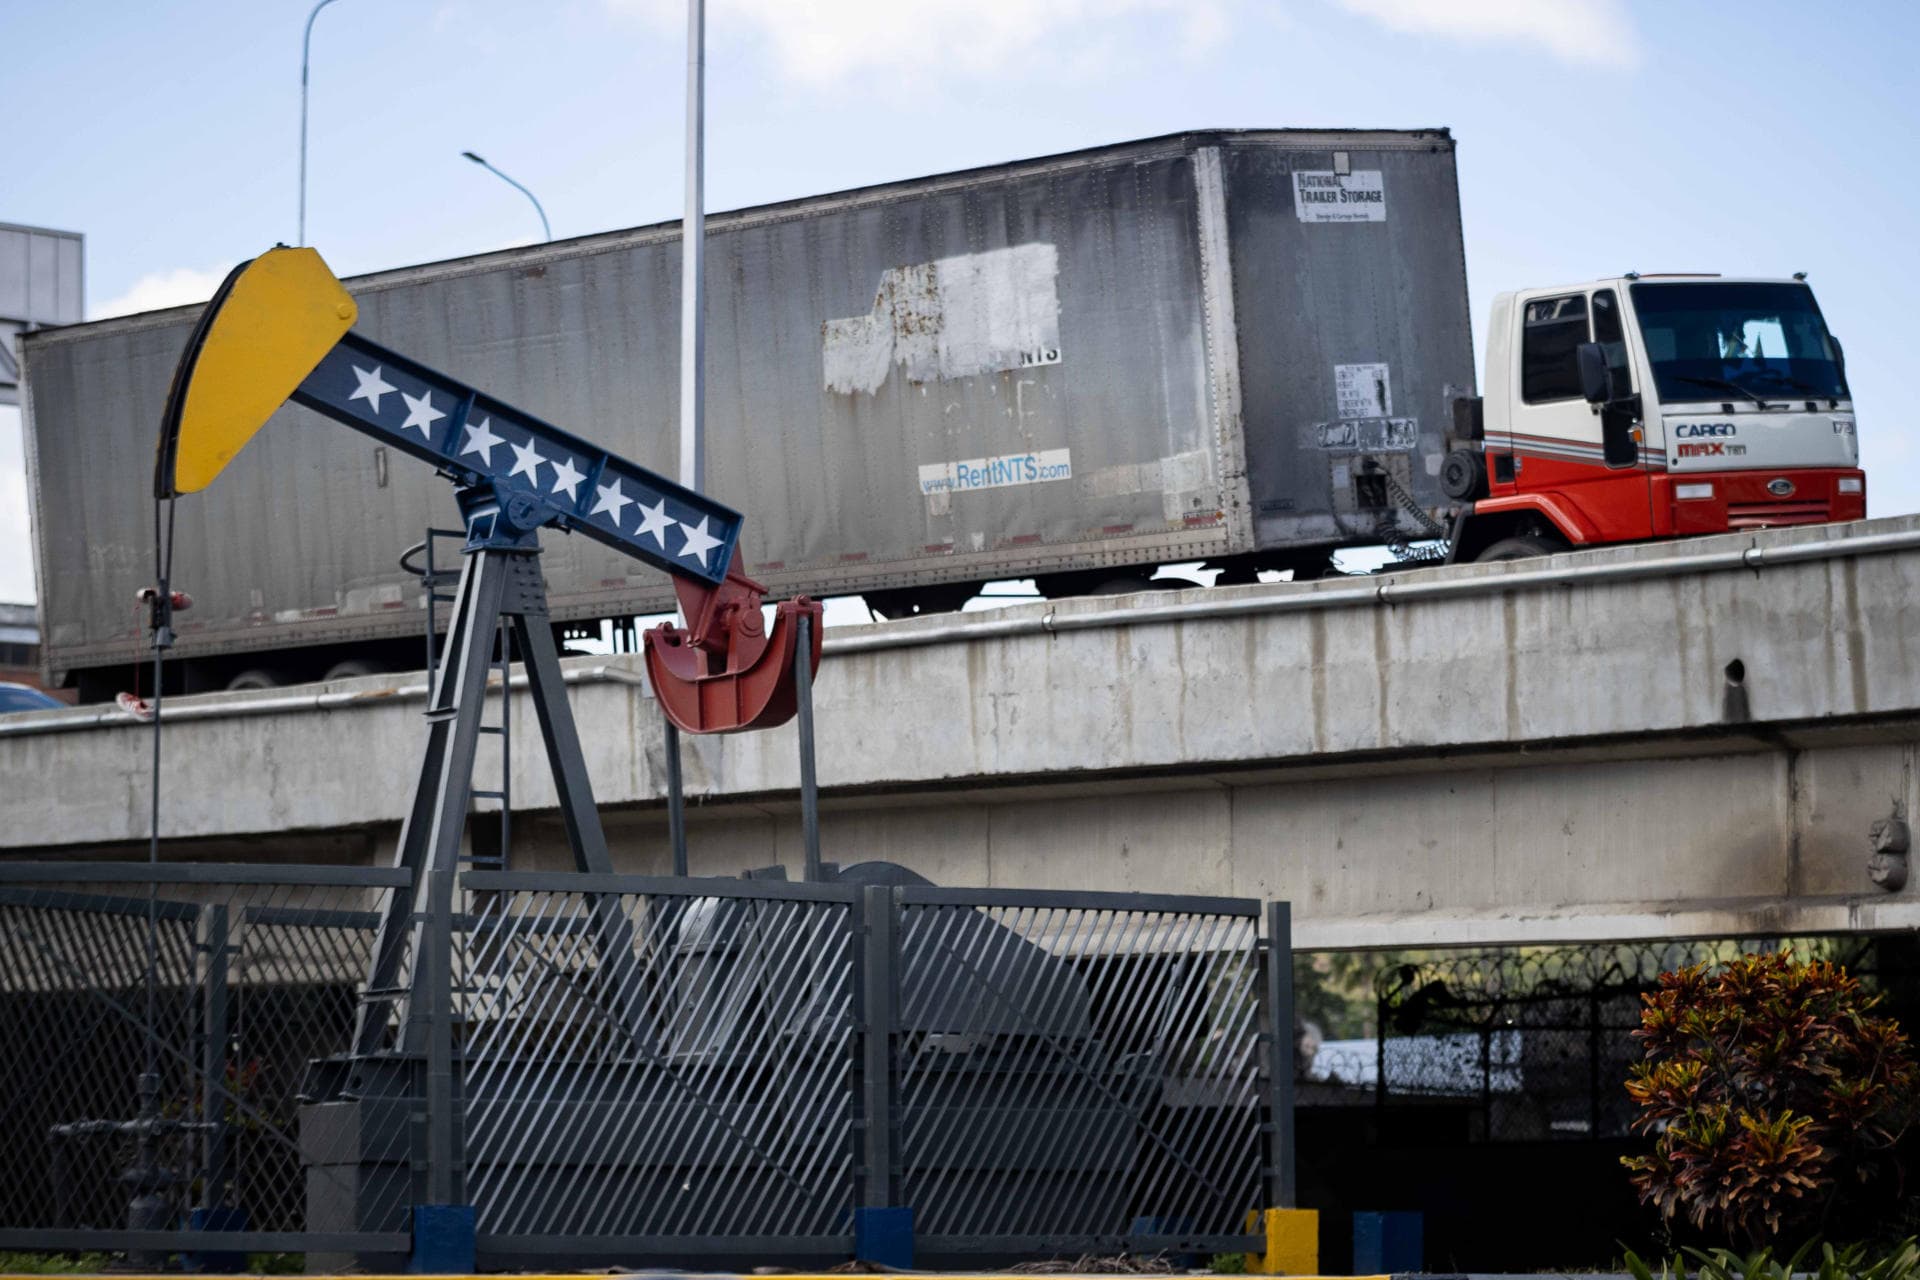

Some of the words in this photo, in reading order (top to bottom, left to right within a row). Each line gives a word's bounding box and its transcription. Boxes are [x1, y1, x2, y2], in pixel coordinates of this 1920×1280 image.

[1299, 189, 1338, 203] TRAILER
[1340, 188, 1382, 203] STORAGE
[1676, 423, 1736, 438] CARGO
[922, 455, 1070, 492] www.RentNTS.com
